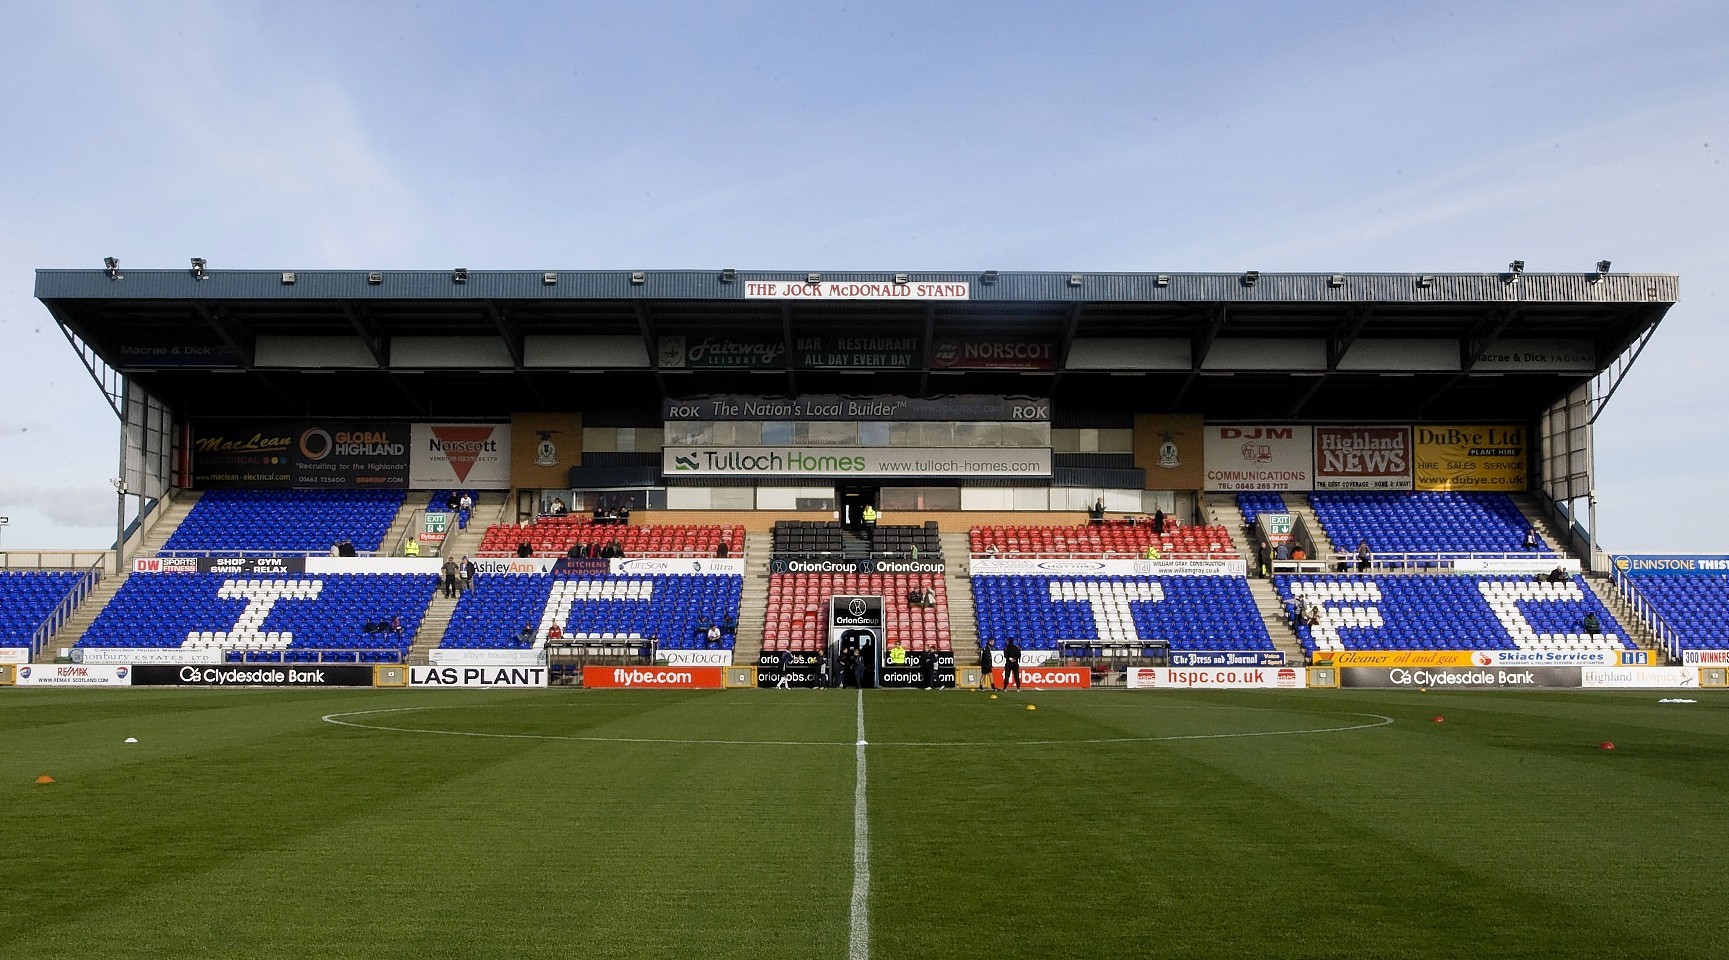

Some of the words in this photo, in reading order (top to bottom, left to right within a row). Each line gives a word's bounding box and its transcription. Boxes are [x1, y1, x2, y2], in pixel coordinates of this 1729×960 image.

[748, 284, 776, 296] THE
[783, 284, 822, 297] JOCK
[829, 284, 911, 298] McDONALD
[917, 285, 966, 298] STAND
[121, 346, 167, 355] Macrae
[171, 346, 181, 355] &
[184, 346, 211, 355] Dick
[688, 336, 785, 363] Fairways
[797, 338, 821, 350] BAR
[838, 337, 918, 351] RESTAURANT
[964, 342, 1052, 359] NORSCOT
[709, 356, 757, 364] LEISURE
[805, 354, 824, 365] ALL
[828, 354, 848, 365] DAY
[853, 354, 886, 365] EVERY
[891, 354, 912, 365] DAY
[1478, 353, 1510, 362] acrae
[1513, 353, 1521, 362] &
[1524, 352, 1546, 362] Dick
[669, 406, 701, 418] ROK
[712, 401, 740, 416] The
[745, 401, 802, 416] Nation's
[806, 401, 842, 416] Local
[1012, 406, 1048, 419] ROK
[335, 431, 390, 444] GLOBAL
[1220, 428, 1293, 439] DJM
[1418, 428, 1482, 449] DuBye
[1488, 428, 1522, 446] Ltd
[195, 433, 292, 453] MacLean
[335, 443, 405, 456] HIGHLAND
[429, 438, 498, 452] Norscott
[1322, 432, 1404, 454] Highland
[340, 461, 350, 470] for
[352, 461, 365, 470] the
[703, 452, 783, 471] Tulloch
[787, 452, 866, 471] Homes
[879, 460, 1040, 472] www.tulloch-homes.com
[1323, 450, 1406, 473] NEWS
[1207, 470, 1306, 481] COMMUNICATIONS
[1419, 476, 1523, 485] www.dubye.co.uk
[137, 561, 159, 571] DW
[709, 563, 733, 571] Ultra
[788, 561, 857, 574] OrionGroup
[876, 561, 945, 574] OrionGroup
[1633, 559, 1696, 570] ENNSTONE
[836, 617, 880, 625] OrionGroup
[463, 651, 484, 660] albyn
[487, 651, 518, 660] housing
[1173, 653, 1187, 664] The
[1188, 653, 1212, 666] Press
[1226, 653, 1258, 665] Journal
[1338, 652, 1389, 663] Gleaner
[1394, 652, 1411, 663] oil
[1414, 652, 1437, 663] and
[1438, 655, 1458, 665] gas
[1498, 652, 1544, 660] Skiach
[1546, 652, 1604, 660] Services
[1686, 652, 1698, 664] 300
[57, 666, 88, 677] RE/MAX
[203, 668, 285, 684] Clydesdale
[288, 668, 325, 682] Bank
[411, 668, 458, 685] LAS
[464, 668, 544, 685] PLANT
[613, 669, 692, 687] flybe.com
[1168, 669, 1264, 686] hspc.co.uk
[1585, 671, 1632, 682] Highland
[1636, 671, 1678, 682] Hospice
[1413, 671, 1495, 687] Clydesdale
[1498, 671, 1535, 684] Bank
